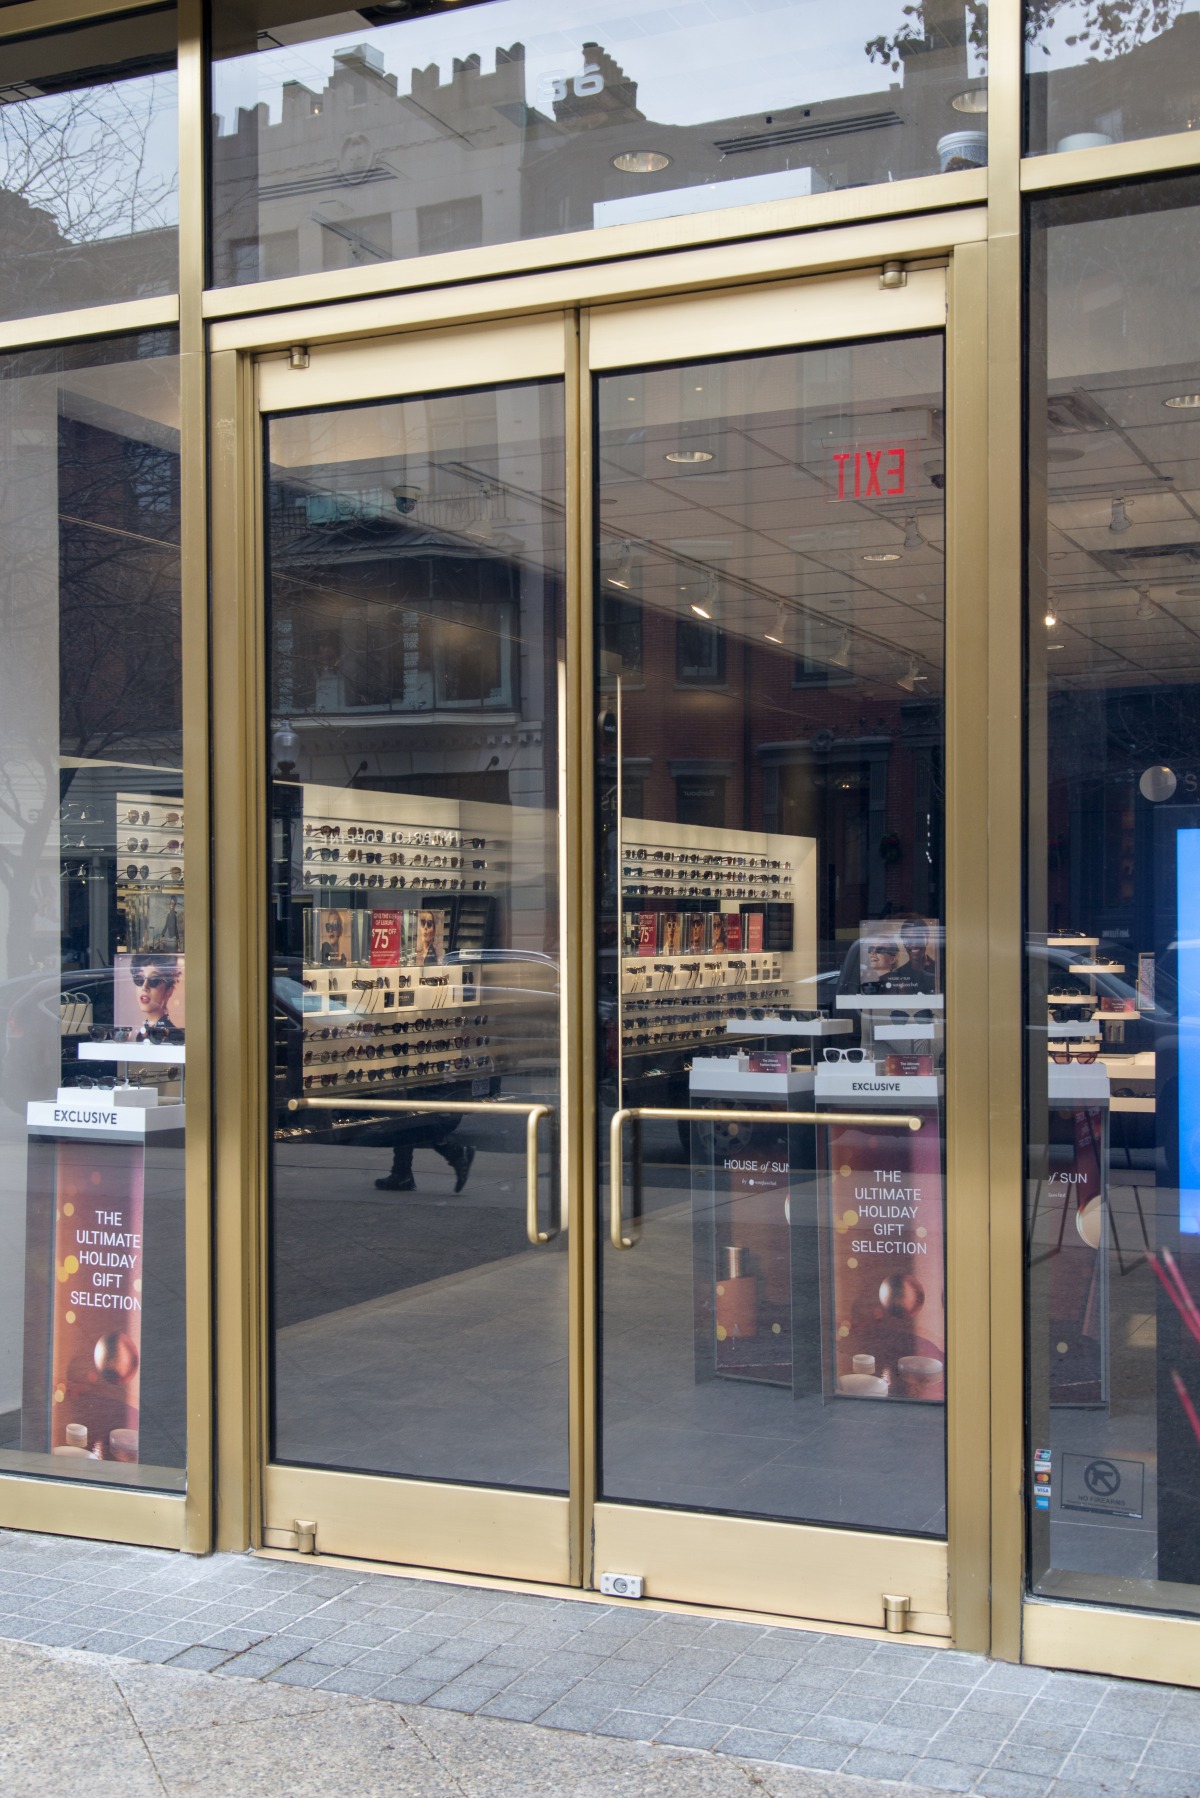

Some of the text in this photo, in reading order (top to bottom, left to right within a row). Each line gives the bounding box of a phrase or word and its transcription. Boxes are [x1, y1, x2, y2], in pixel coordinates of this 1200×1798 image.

[372, 928, 389, 949] $75
[852, 1082, 901, 1092] EXCLUSIVE
[54, 1109, 118, 1125] EXCLUSIVE
[723, 1159, 758, 1171] HOUSE
[760, 1161, 771, 1174] of
[873, 1169, 902, 1183] THE
[1060, 1172, 1088, 1184] SUN
[854, 1187, 922, 1201] ULTIMATE
[95, 1210, 123, 1226] THE
[858, 1205, 919, 1219] HOLIDAY
[873, 1223, 905, 1236] GIFT
[76, 1229, 141, 1249] ULTIMATE
[851, 1240, 927, 1255] SELECTION
[79, 1250, 138, 1269] HOLIDAY
[92, 1272, 123, 1289] GIFT
[1089, 1496, 1126, 1506] FIREARMS
